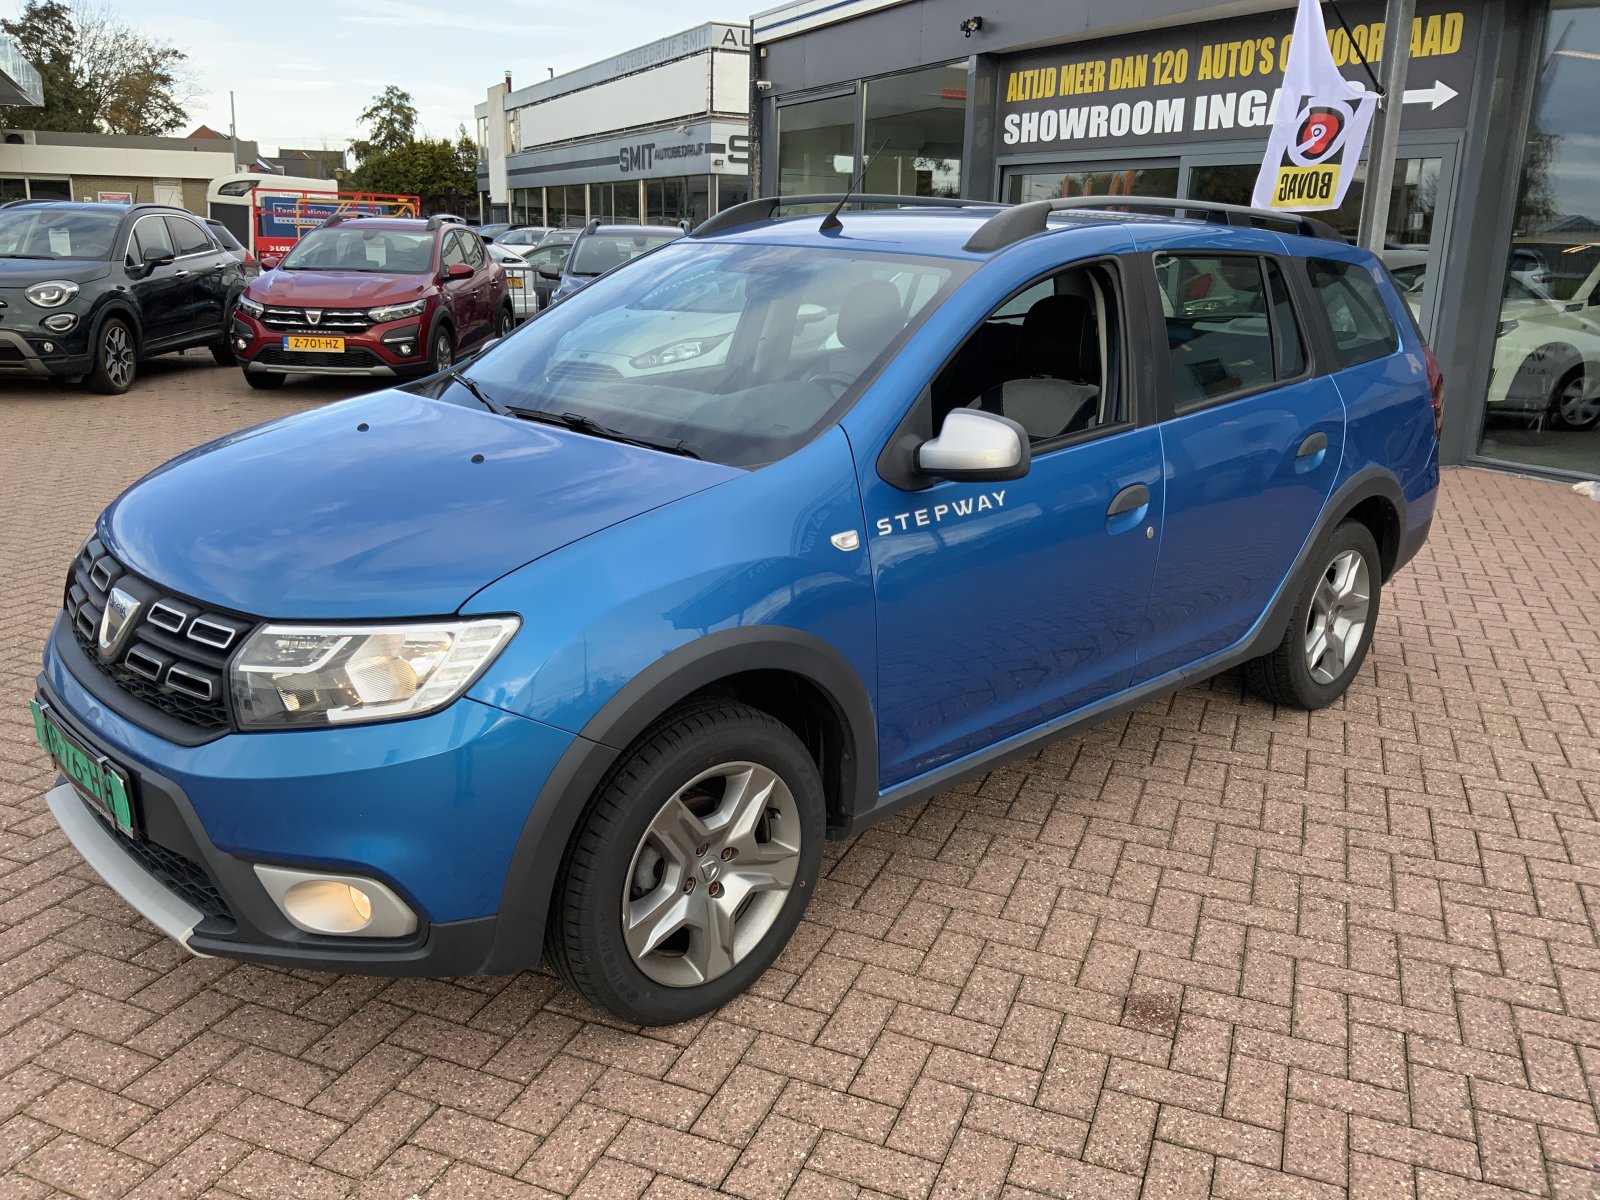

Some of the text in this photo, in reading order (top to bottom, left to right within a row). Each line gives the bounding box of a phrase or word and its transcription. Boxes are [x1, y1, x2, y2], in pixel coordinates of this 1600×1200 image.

[614, 28, 709, 74] AUTOBEDRIJF SMIT
[1006, 67, 1057, 102] ALTIJD
[1059, 60, 1106, 96] MEER
[1108, 54, 1148, 90] DAN
[1152, 48, 1188, 86] 120
[1197, 37, 1275, 81] AUTO'S
[1326, 12, 1464, 67] VOORAAD
[1003, 97, 1186, 145] SHOWROOM
[619, 143, 705, 172] SMIT AUTOBEDRIJF
[294, 338, 339, 349] Z-701-HZ
[876, 490, 1006, 536] STEPWAY
